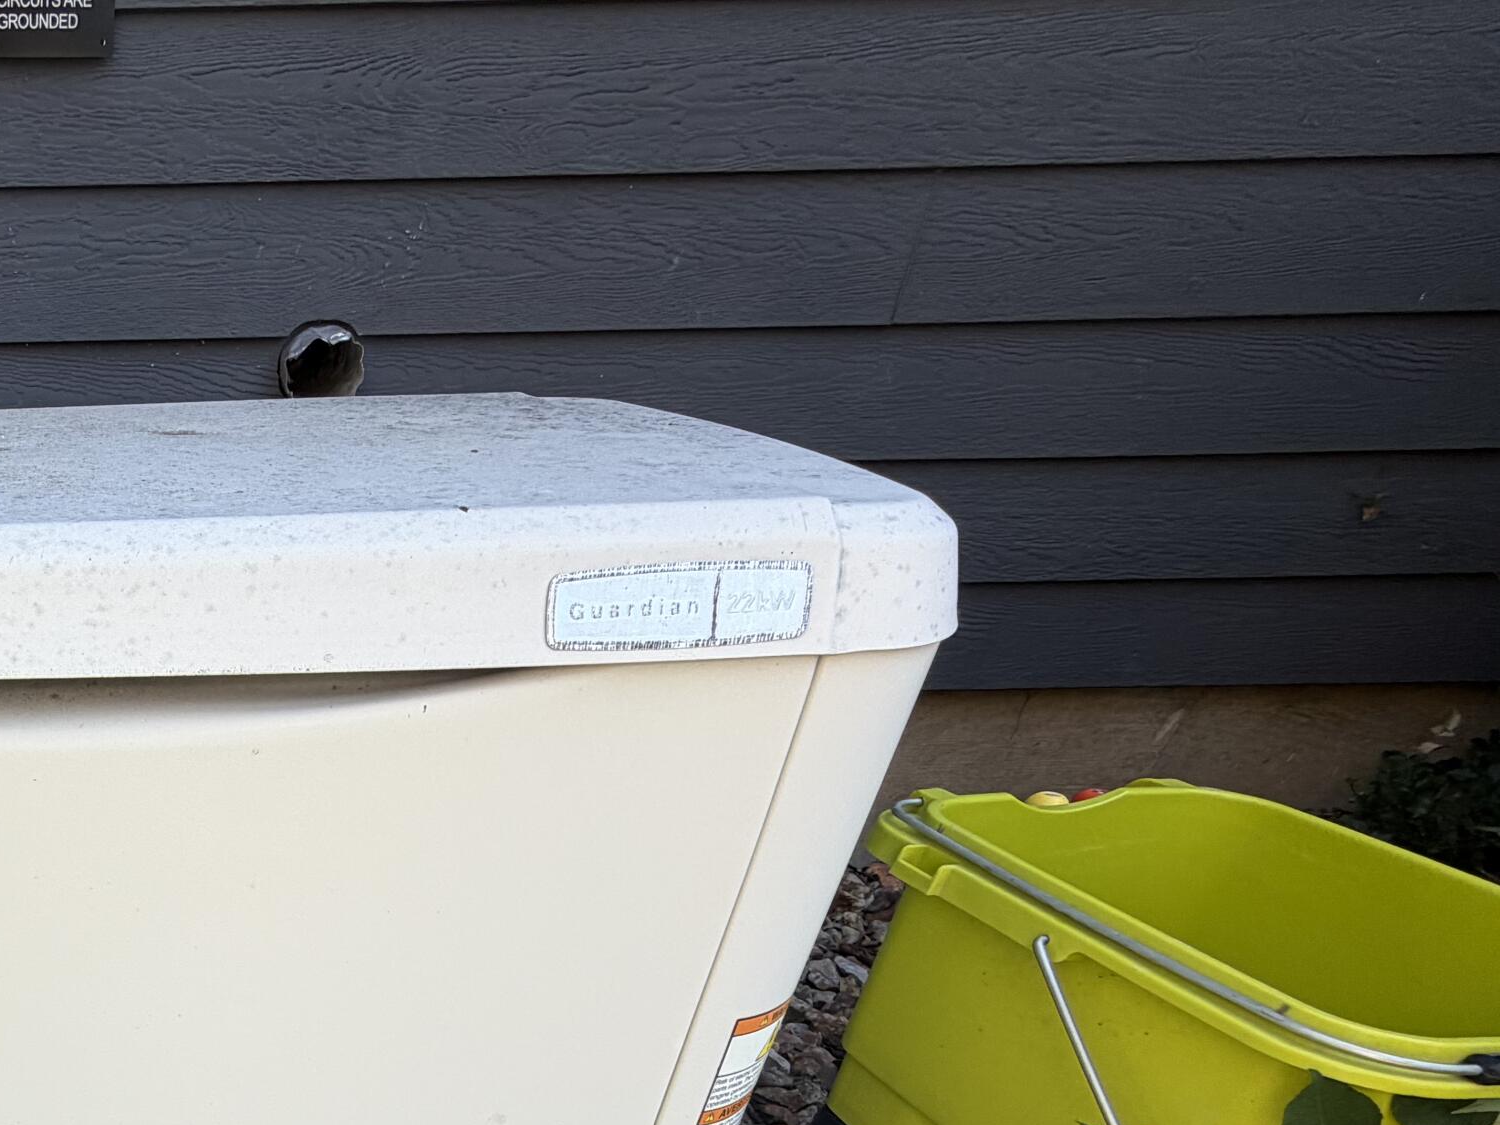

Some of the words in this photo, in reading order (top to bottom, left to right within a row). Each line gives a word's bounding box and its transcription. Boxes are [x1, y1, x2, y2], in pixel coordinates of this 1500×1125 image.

[63, 0, 93, 8] ARE
[568, 597, 700, 621] Guardian
[726, 591, 796, 614] 22kW
